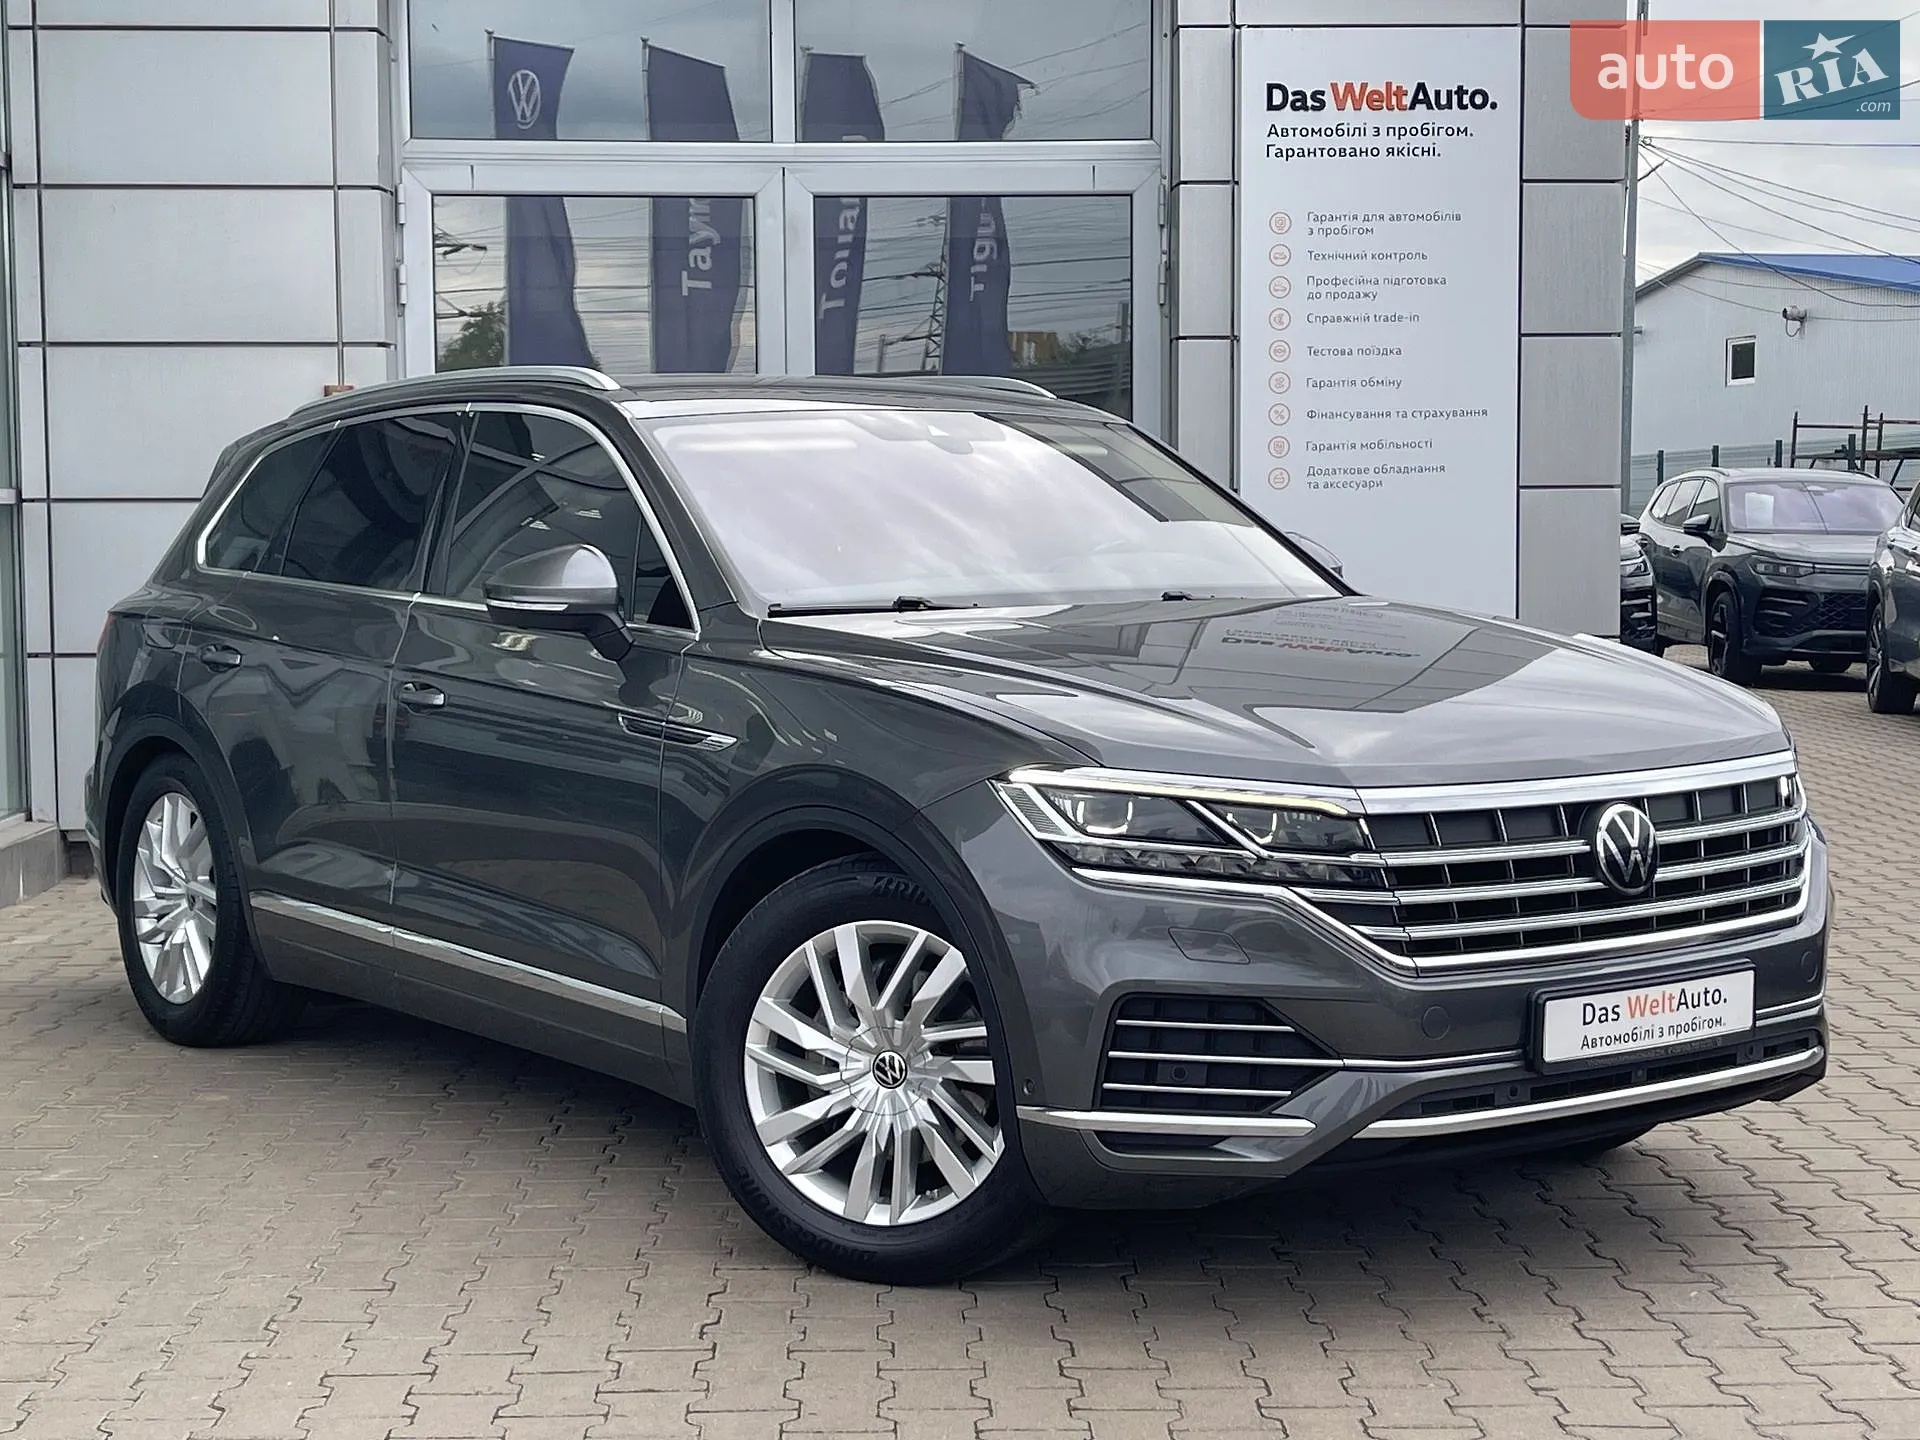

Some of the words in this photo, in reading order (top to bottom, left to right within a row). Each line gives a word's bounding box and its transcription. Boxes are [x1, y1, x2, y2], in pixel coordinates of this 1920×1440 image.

[1266, 83, 1326, 112] Das
[1330, 81, 1498, 111] WeltAuto.
[1267, 123, 1367, 138] Автомобілі
[1372, 125, 1381, 137] з
[1386, 122, 1474, 140] пробігом.
[1266, 144, 1381, 161] Гарантовано
[1385, 142, 1442, 157] якісні.
[1307, 211, 1359, 224] Гарантія
[1362, 213, 1385, 224] для
[1388, 210, 1462, 222] автомобілів
[1308, 227, 1314, 236] з
[1317, 225, 1374, 238] пробігом
[1308, 250, 1368, 261] Технічний
[1371, 251, 1428, 262] контроль
[1306, 276, 1380, 288] Професійна
[1383, 275, 1447, 287] підготовка
[1307, 291, 1322, 301] до
[1325, 290, 1378, 301] продажу
[1306, 313, 1370, 326] Справжній
[1374, 312, 1420, 323] trade-in
[1307, 346, 1353, 357] Тестова
[1357, 345, 1402, 358] поїздка
[1306, 378, 1357, 391] Гарантія
[1361, 377, 1402, 389] обміну
[1306, 409, 1392, 422] Фінансування
[1396, 410, 1408, 419] та
[1411, 408, 1488, 420] страхування
[1306, 441, 1357, 453] Гарантія
[1360, 438, 1433, 450] мобільності
[1306, 466, 1370, 478] Додаткове
[1373, 464, 1446, 475] обладнання
[1307, 479, 1319, 489] та
[1323, 478, 1383, 491] аксесуари
[1582, 1003, 1620, 1026] Das
[1627, 986, 1727, 1019] WeltAuto.
[1581, 1023, 1654, 1050] Автомобілі
[1658, 1027, 1664, 1038] з
[1668, 1017, 1726, 1038] пробігом.
